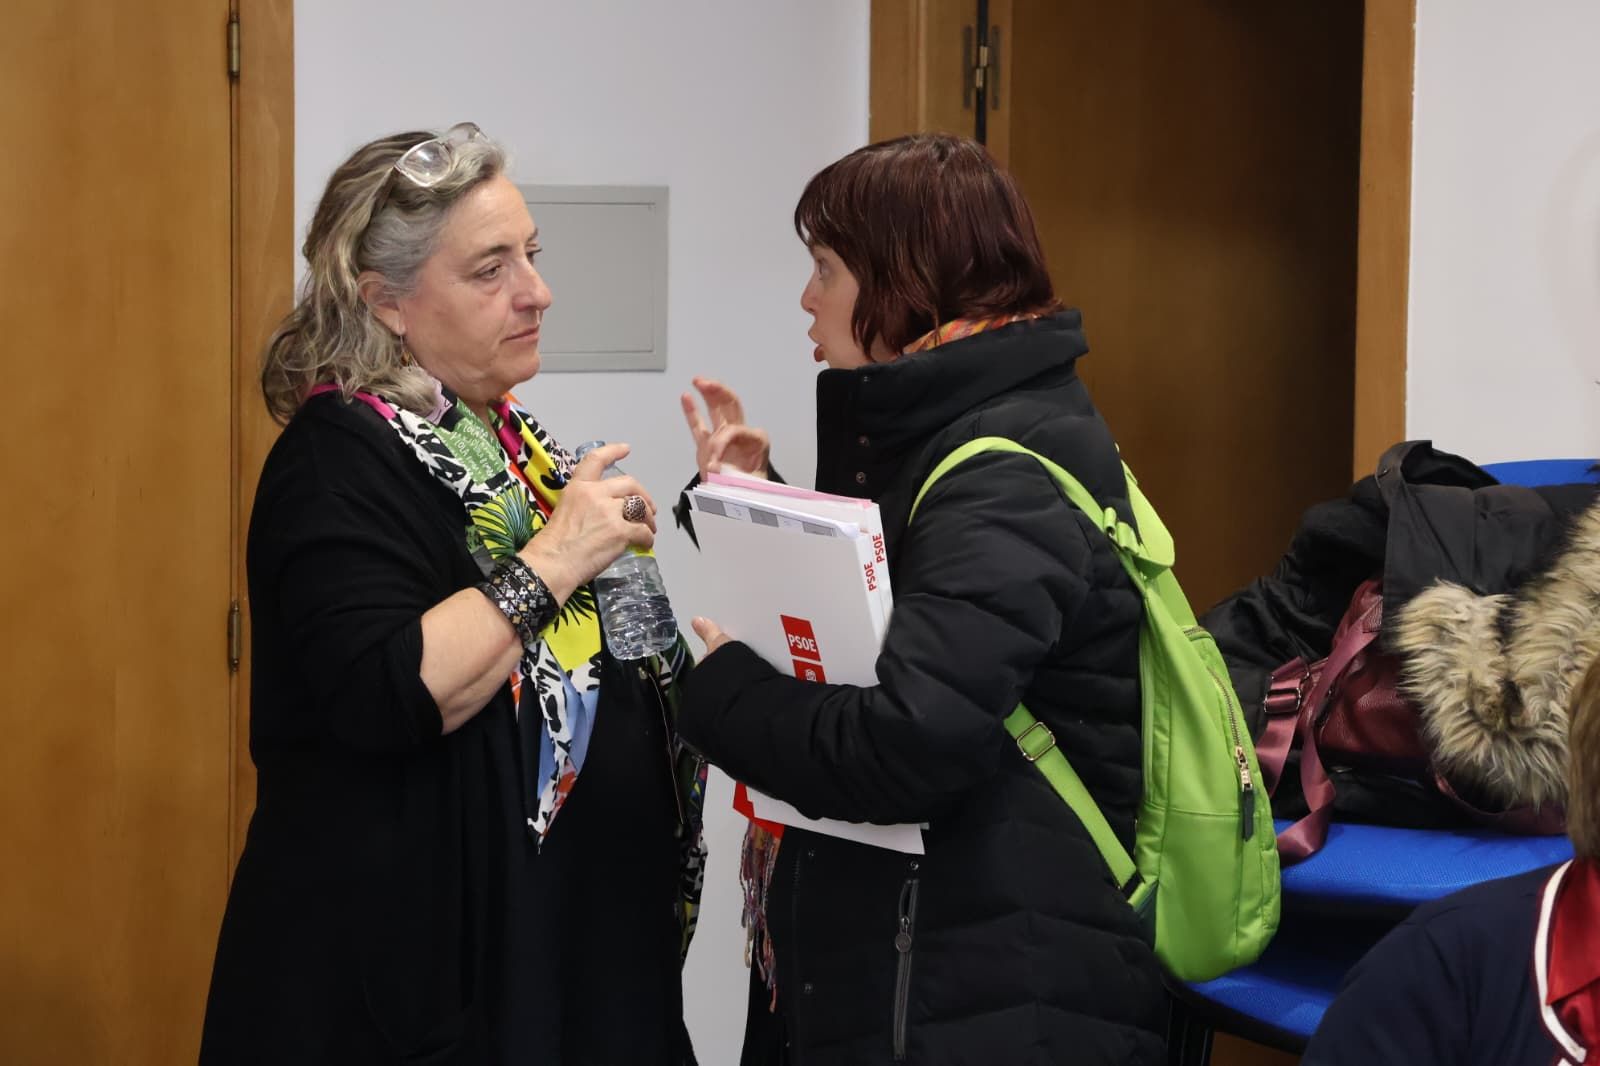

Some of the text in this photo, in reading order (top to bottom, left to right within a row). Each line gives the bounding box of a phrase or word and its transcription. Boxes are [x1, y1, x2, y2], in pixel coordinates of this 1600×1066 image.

[872, 533, 884, 563] PSOE
[864, 562, 876, 591] PSOE
[788, 634, 817, 652] PSOE
